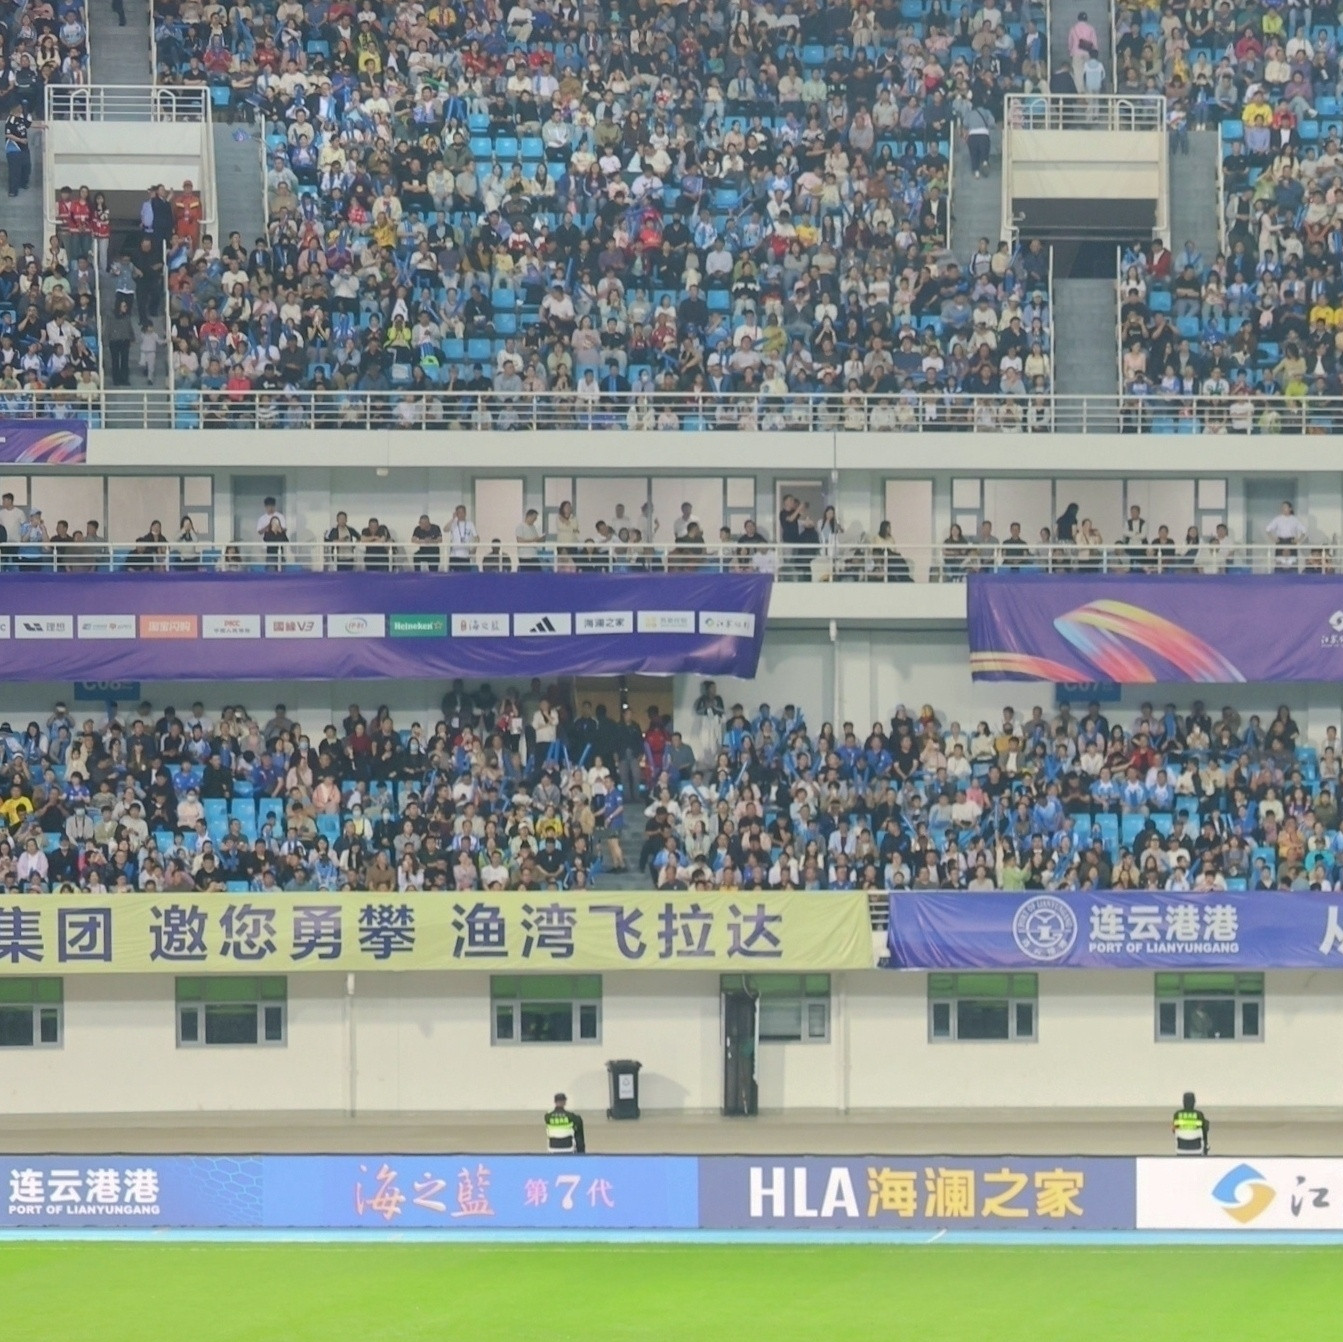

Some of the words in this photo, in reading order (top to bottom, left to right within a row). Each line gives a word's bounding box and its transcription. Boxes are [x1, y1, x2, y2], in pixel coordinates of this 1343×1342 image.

[394, 620, 433, 631] Heineken
[0, 905, 113, 964] 集团
[149, 902, 417, 961] 邀您勇攀
[451, 901, 785, 960] 渔湾飞拉达
[1089, 904, 1239, 942] 连云港港
[1089, 943, 1123, 954] PORT
[1126, 943, 1143, 954] OF
[1146, 943, 1239, 954] LIANYUNGANG
[8, 1168, 161, 1204] 连云港港
[523, 1173, 616, 1211] 第7代
[866, 1166, 1086, 1220] 海澜之家
[8, 1205, 41, 1216] PORT
[45, 1205, 63, 1216] OF
[65, 1205, 161, 1216] LIANYUNGANG
